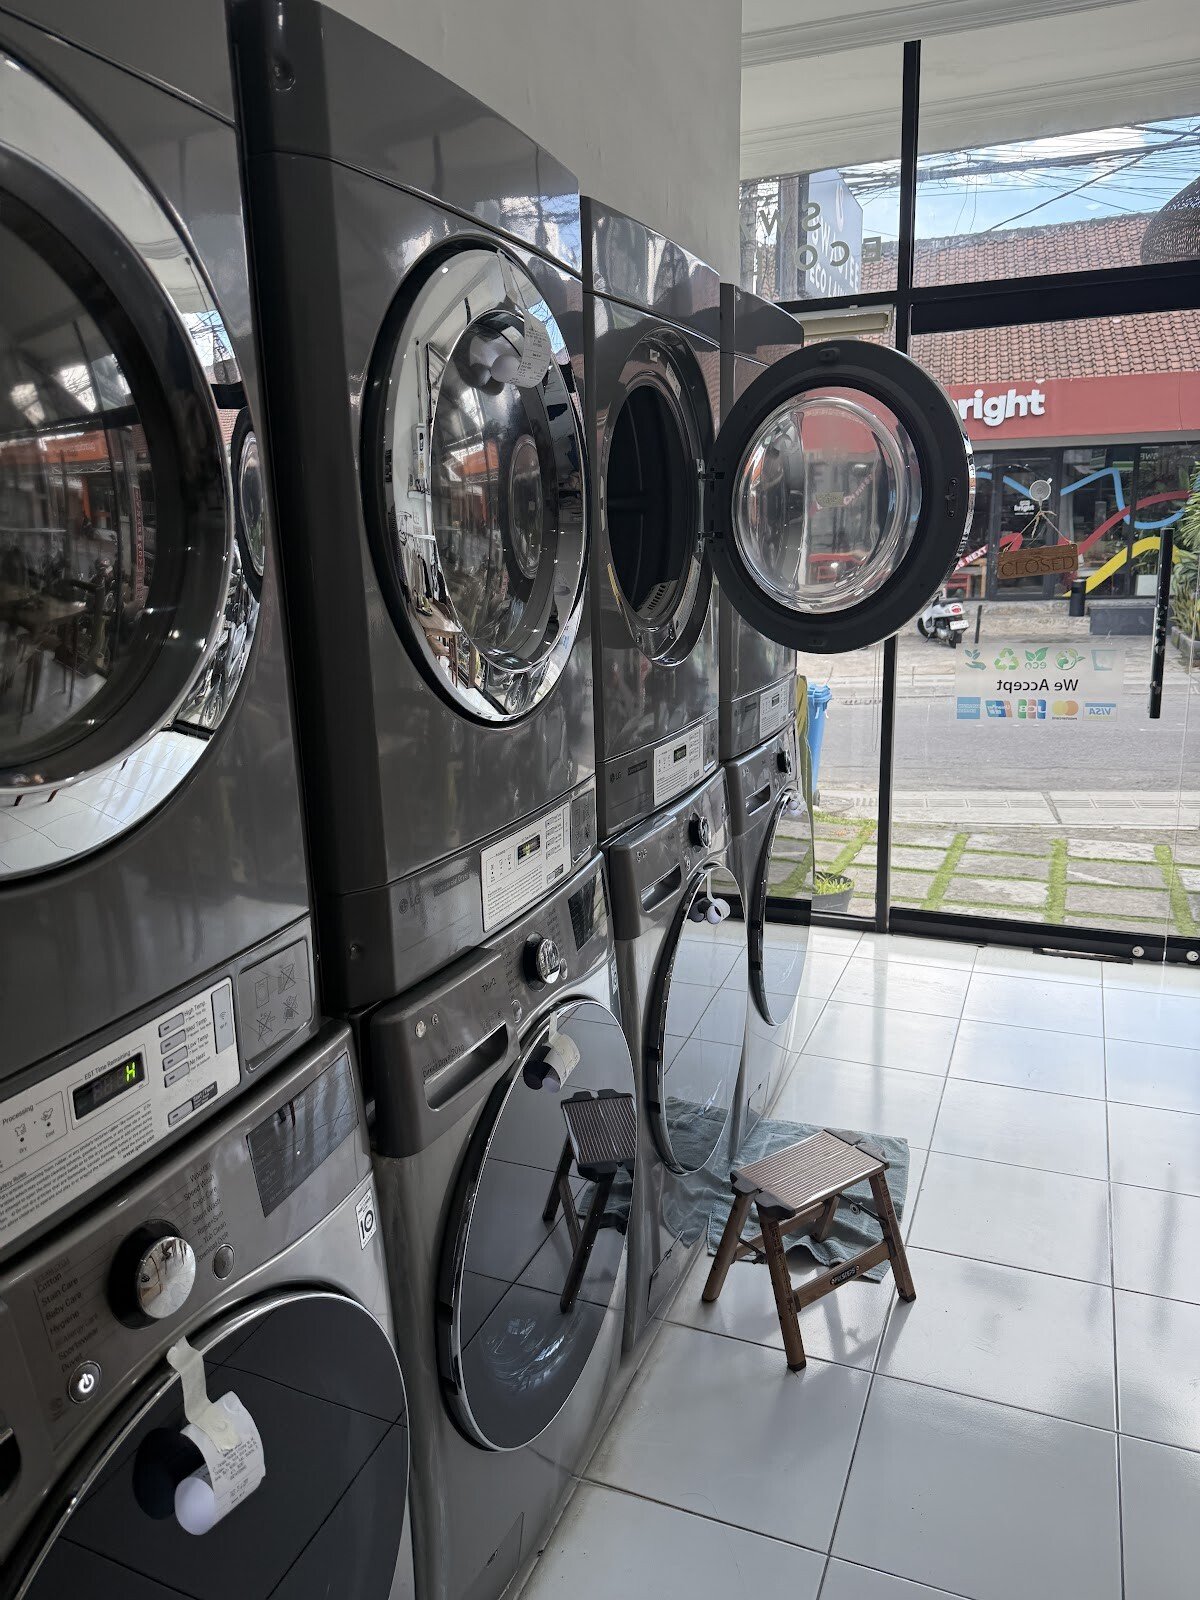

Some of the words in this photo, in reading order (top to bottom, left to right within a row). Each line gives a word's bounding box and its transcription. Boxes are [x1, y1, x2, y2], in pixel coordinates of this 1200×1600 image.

[952, 389, 1045, 426] right
[1001, 556, 1074, 577] CLOSED
[95, 1062, 106, 1073] Time
[107, 1049, 130, 1067] Remaining
[2, 1105, 34, 1125] Processing
[361, 1209, 374, 1240] 10
[37, 1272, 62, 1294] Cotton
[41, 1287, 62, 1307] Stain
[61, 1277, 79, 1292] Care
[45, 1303, 65, 1321] Baby
[65, 1291, 82, 1308] Care
